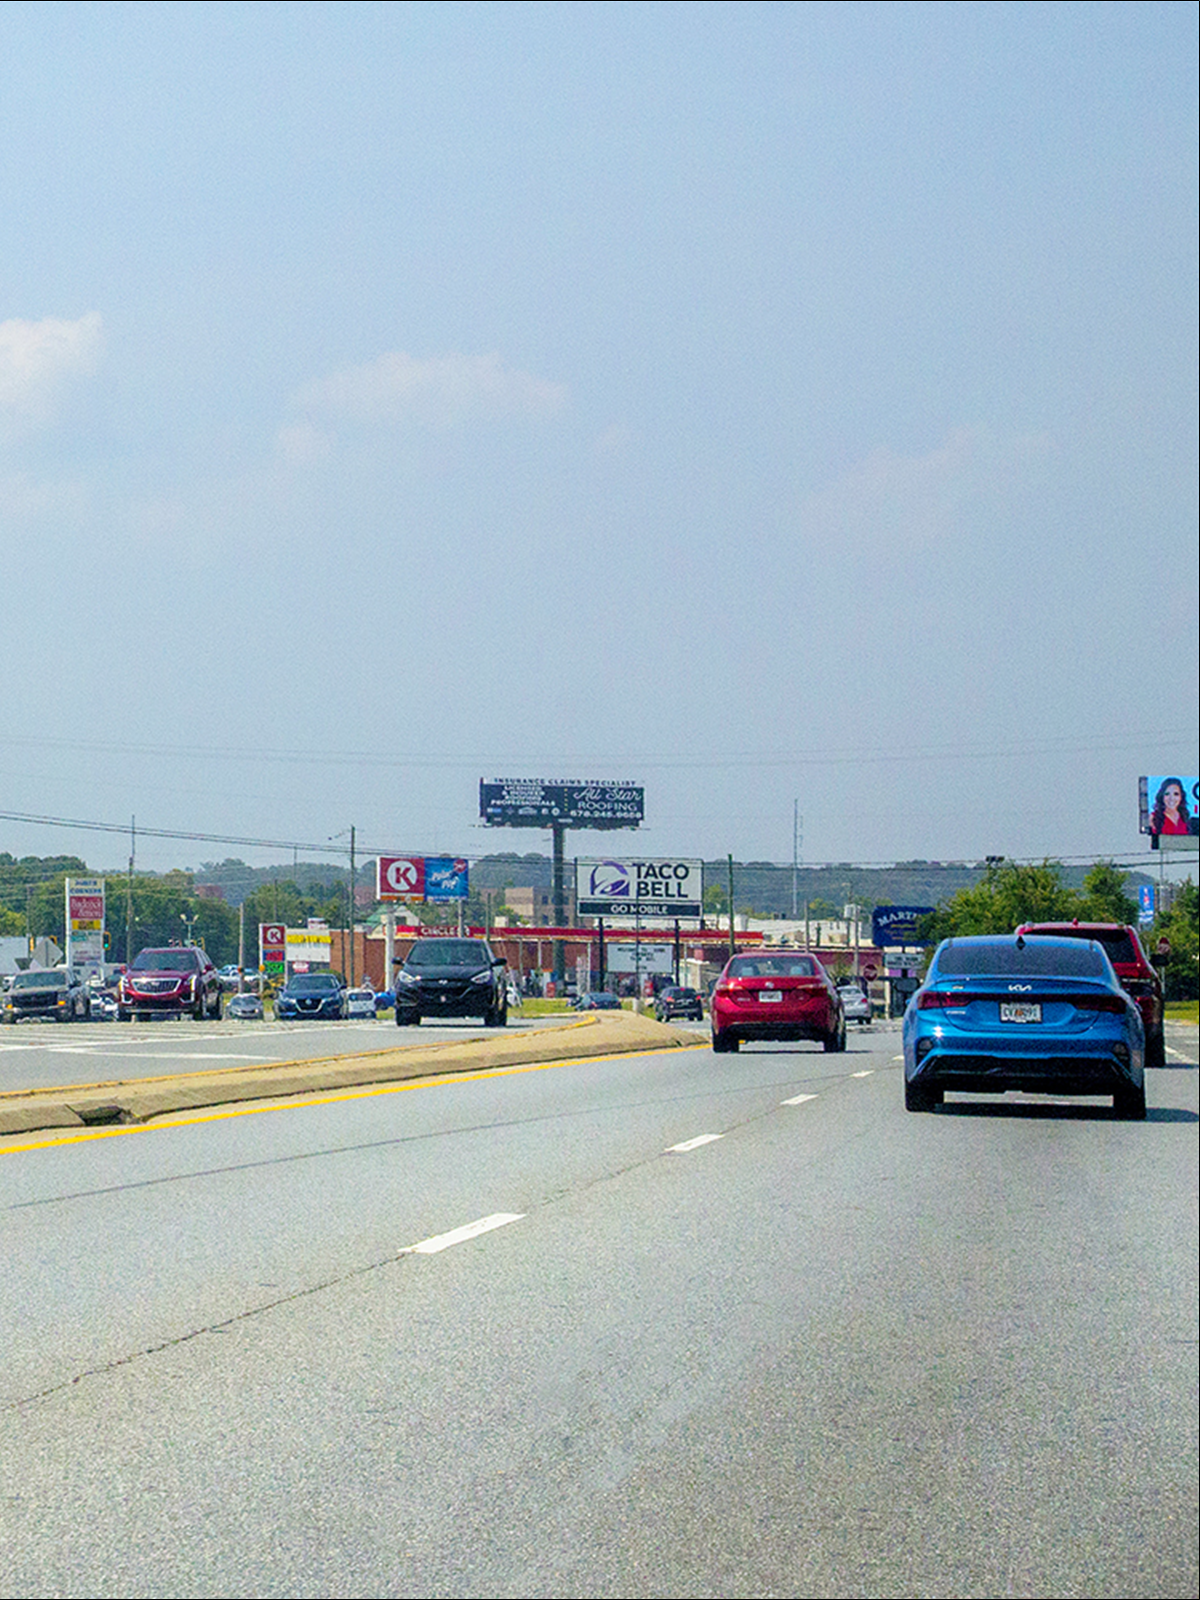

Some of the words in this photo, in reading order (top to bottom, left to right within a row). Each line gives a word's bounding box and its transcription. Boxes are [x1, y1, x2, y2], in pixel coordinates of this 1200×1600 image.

[577, 800, 638, 811] ROOFING
[632, 862, 690, 880] TACO
[637, 881, 688, 898] BELL
[610, 904, 628, 914] GO
